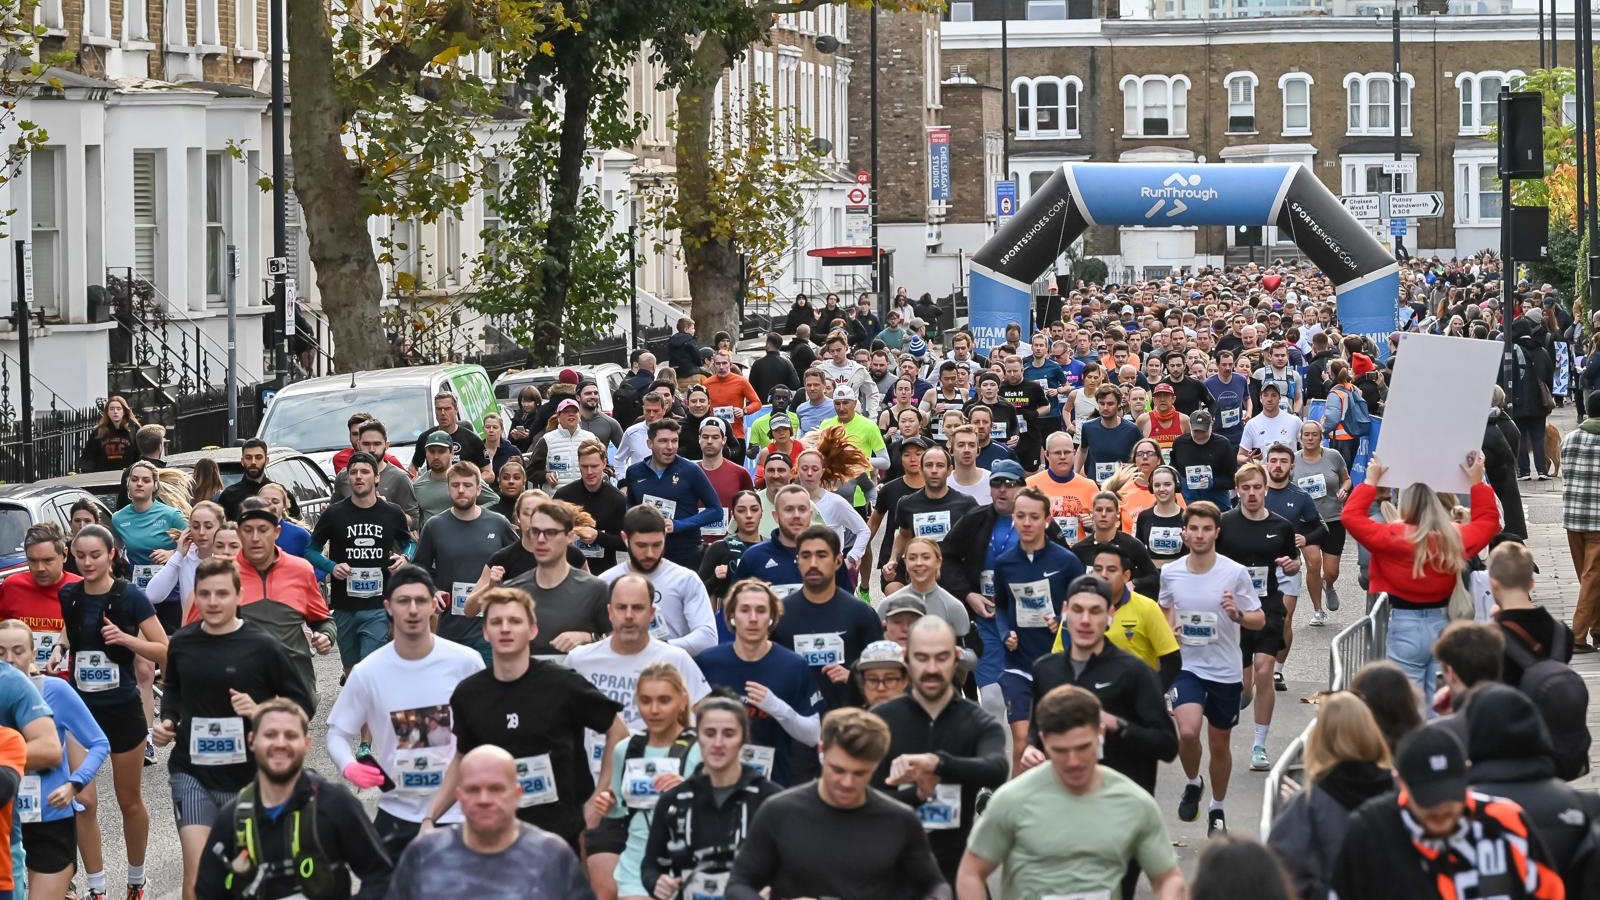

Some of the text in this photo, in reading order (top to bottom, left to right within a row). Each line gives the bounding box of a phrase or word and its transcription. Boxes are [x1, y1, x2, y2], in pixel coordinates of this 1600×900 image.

[857, 174, 868, 182] GE
[932, 155, 940, 188] STUDIOS
[940, 146, 948, 198] CHELSEAGATE
[1141, 187, 1218, 202] RunThrough
[1000, 198, 1067, 265] SPORTSSHOES.COM
[1291, 202, 1358, 271] SPORTSSHOES.COM
[971, 326, 1006, 338] VITAM
[346, 523, 384, 539] NIKE
[920, 524, 944, 535] 1863
[1154, 539, 1177, 548] 3328
[345, 547, 384, 559] TOKYO
[354, 581, 376, 590] 2117
[804, 652, 836, 664] 1649
[80, 668, 111, 681] 3605
[590, 672, 638, 690] SPRAN
[199, 739, 234, 752] 3283
[404, 774, 441, 787] 2312
[520, 779, 544, 795] 28
